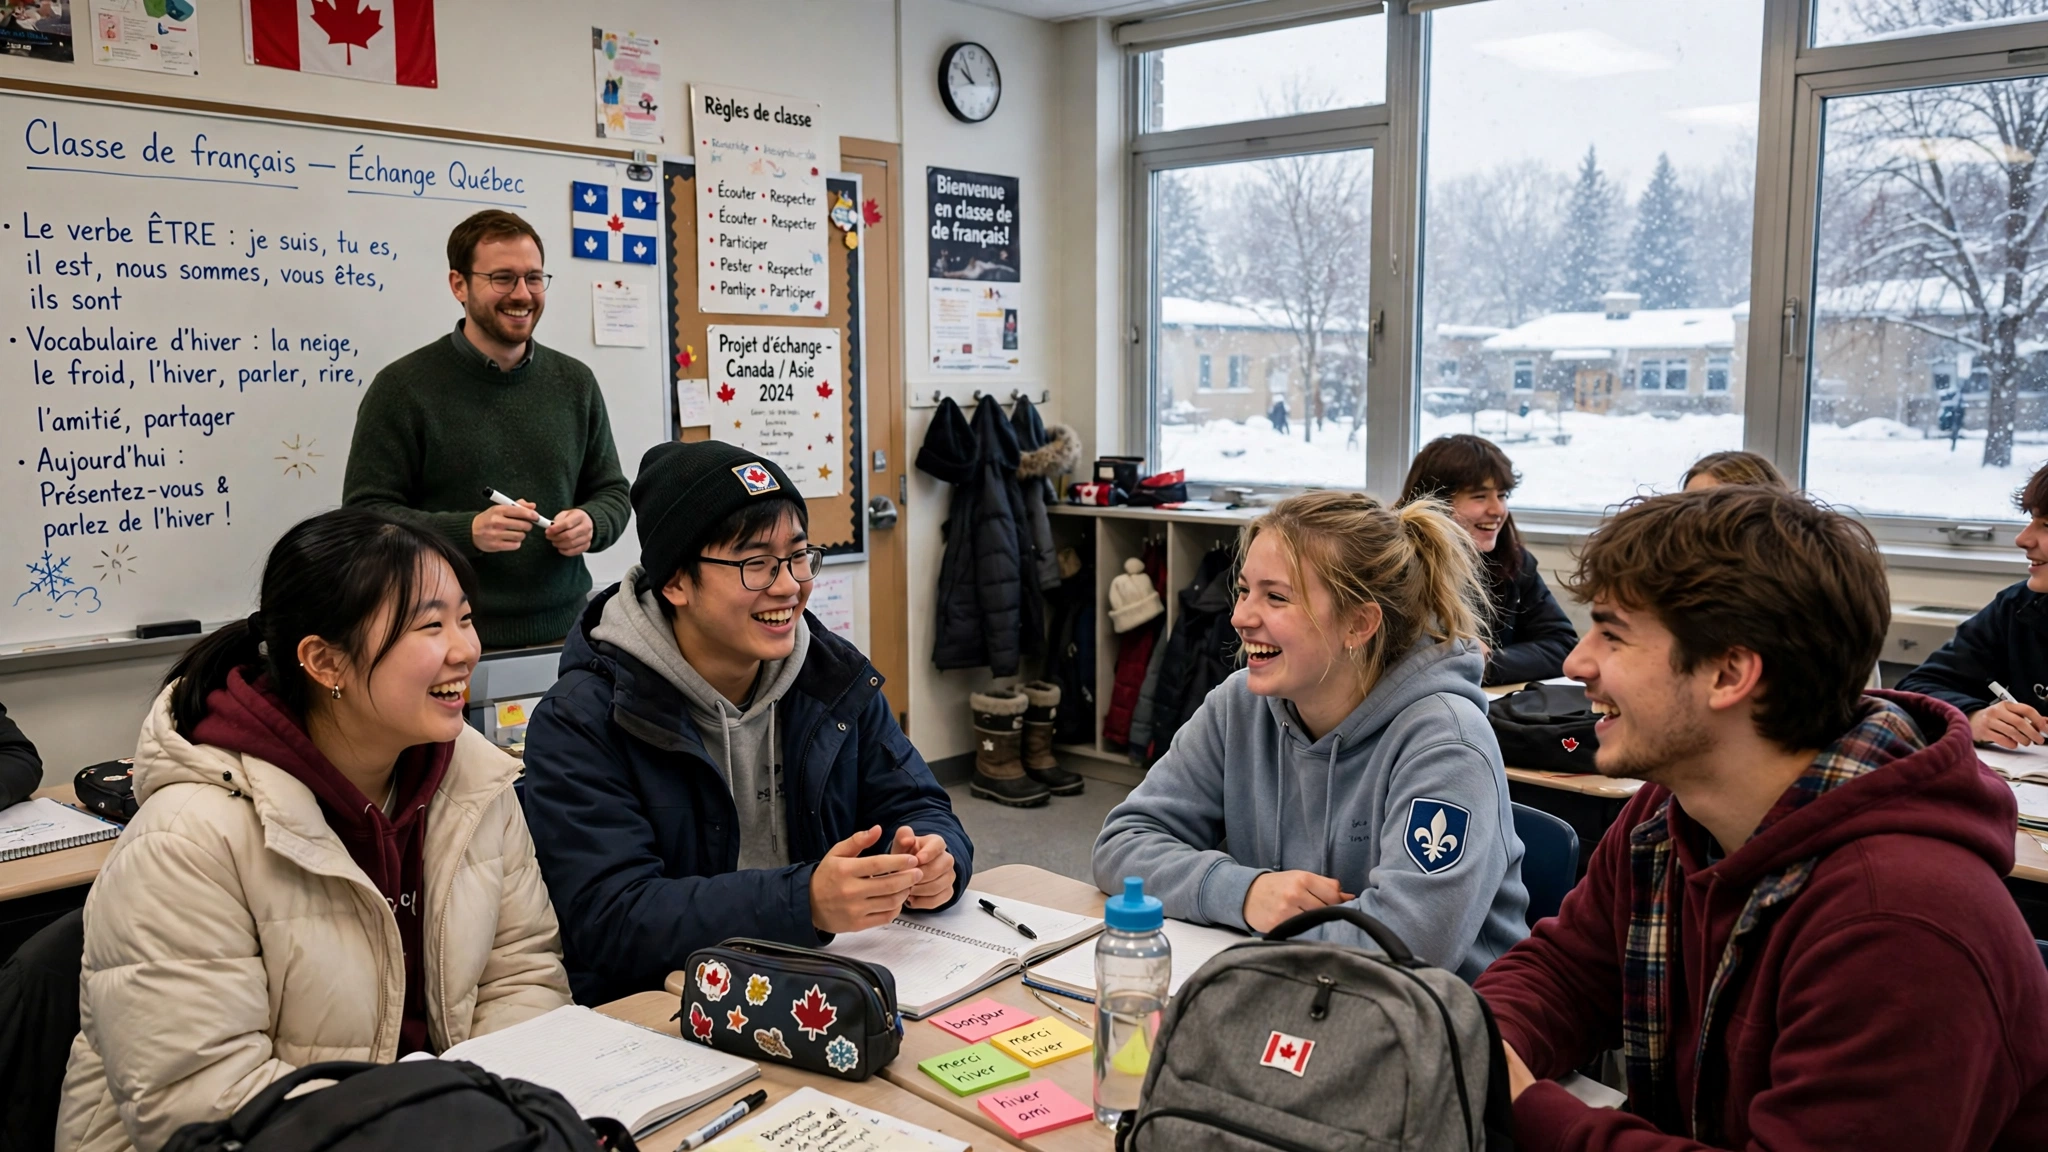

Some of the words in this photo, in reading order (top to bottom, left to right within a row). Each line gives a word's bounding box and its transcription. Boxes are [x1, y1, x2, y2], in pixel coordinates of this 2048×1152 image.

[705, 96, 749, 122] Règles
[754, 103, 769, 121] de
[774, 106, 811, 127] classe
[26, 119, 125, 159] Classe
[143, 132, 175, 163] de
[192, 134, 296, 178] français
[348, 145, 436, 195] Échange
[449, 161, 524, 193] Québec
[718, 180, 756, 199] Écouter
[770, 189, 815, 207] Respecter
[937, 175, 1004, 200] Bienvenue
[720, 205, 757, 225] Écouter
[772, 214, 816, 232] Respecter
[935, 203, 951, 217] en
[955, 200, 993, 221] classe
[996, 204, 1012, 223] de
[24, 212, 54, 239] Le
[67, 217, 133, 242] verbe
[149, 212, 215, 245] ÊTRE
[246, 229, 268, 258] je
[280, 233, 325, 256] suis,
[337, 231, 358, 253] tu
[370, 242, 396, 260] es,
[720, 233, 767, 254] Participer
[932, 220, 949, 240] de
[953, 221, 1009, 248] français!
[27, 250, 40, 274] il
[56, 252, 101, 282] est,
[117, 263, 167, 278] nous
[180, 265, 267, 286] sommes,
[281, 269, 324, 284] vous
[335, 264, 383, 291] êtes,
[721, 257, 752, 272] Pester
[768, 261, 812, 278] Respecter
[31, 284, 58, 309] ils
[73, 287, 122, 310] sont
[770, 284, 815, 302] Participer
[26, 326, 157, 351] Vocabulaire
[171, 328, 241, 351] d'hiver
[272, 328, 289, 351] la
[301, 334, 357, 361] neige,
[720, 334, 757, 358] Projet
[763, 336, 821, 360] d'échange
[34, 360, 55, 385] le
[68, 359, 134, 389] froid,
[150, 360, 224, 388] l'hiver,
[239, 360, 306, 392] parler,
[320, 364, 362, 386] rire,
[726, 359, 774, 377] Canada
[789, 360, 814, 378] Asie
[760, 384, 793, 401] 2024
[38, 407, 130, 433] l'amitié,
[145, 404, 235, 438] partager
[38, 444, 165, 481] Aujourd'hui
[41, 480, 203, 506] Présentez-vous
[218, 476, 228, 493] &
[44, 513, 109, 547] parlez
[119, 510, 142, 532] de
[154, 507, 214, 529] l'hiver
[944, 1008, 1005, 1030] bonjour
[1008, 1027, 1052, 1045] merci
[937, 1052, 981, 1071] merci
[1021, 1041, 1063, 1058] hiver
[952, 1065, 996, 1083] hiver
[993, 1090, 1040, 1109] hiver
[1018, 1104, 1051, 1121] ami
